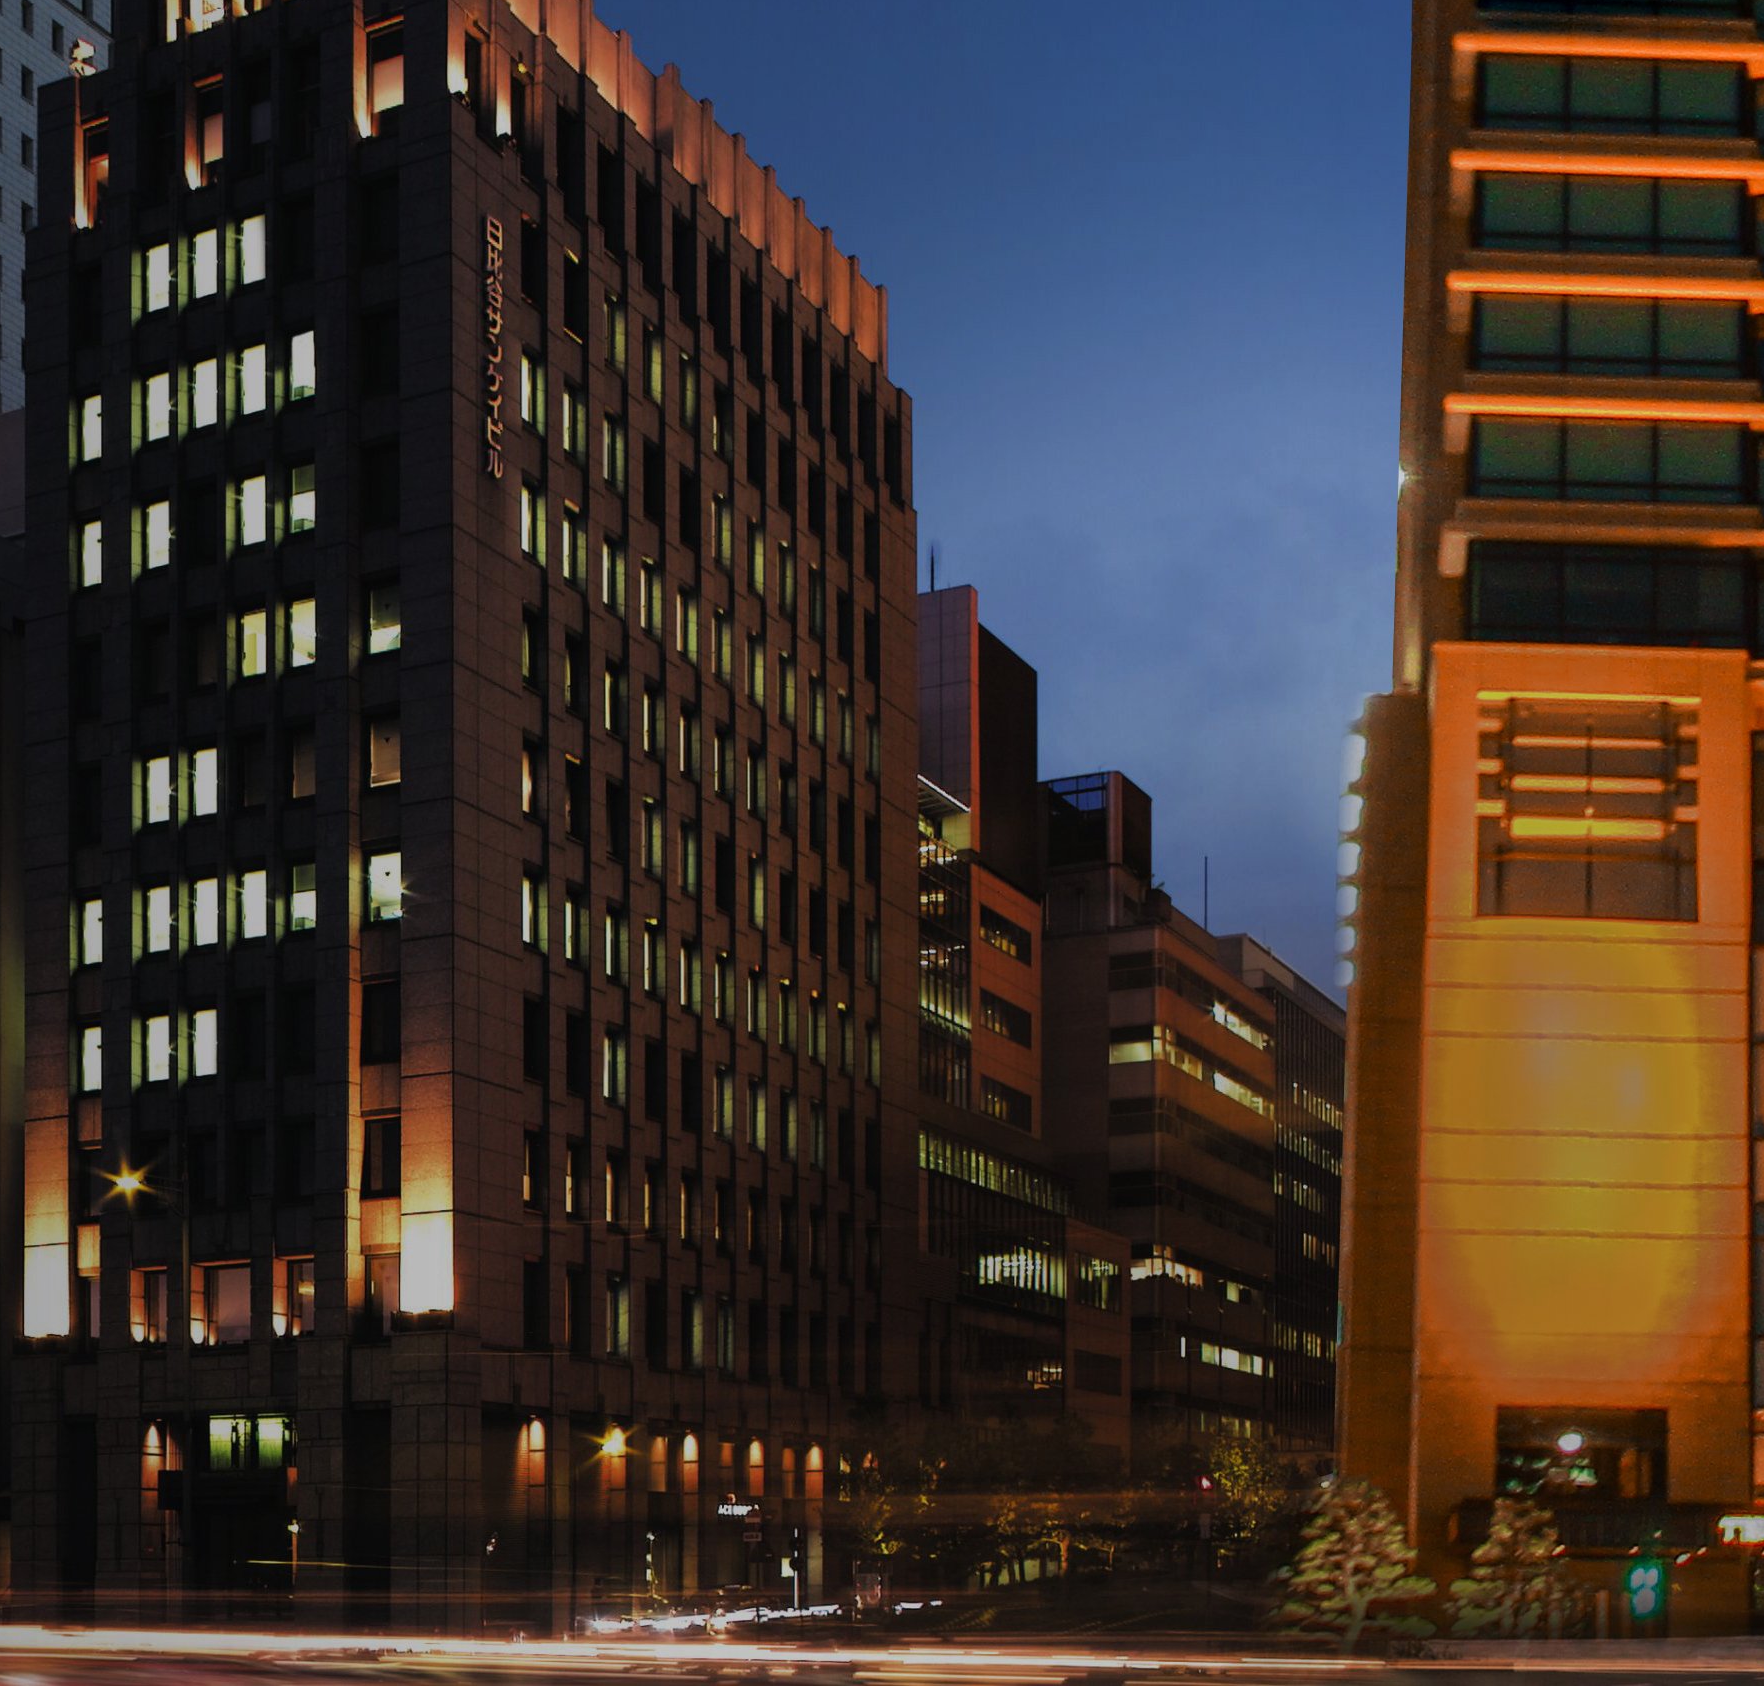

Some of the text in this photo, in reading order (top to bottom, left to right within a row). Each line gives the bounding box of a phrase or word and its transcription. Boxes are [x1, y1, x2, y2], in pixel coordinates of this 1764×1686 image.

[487, 216, 504, 478] 日比谷サンケイビル
